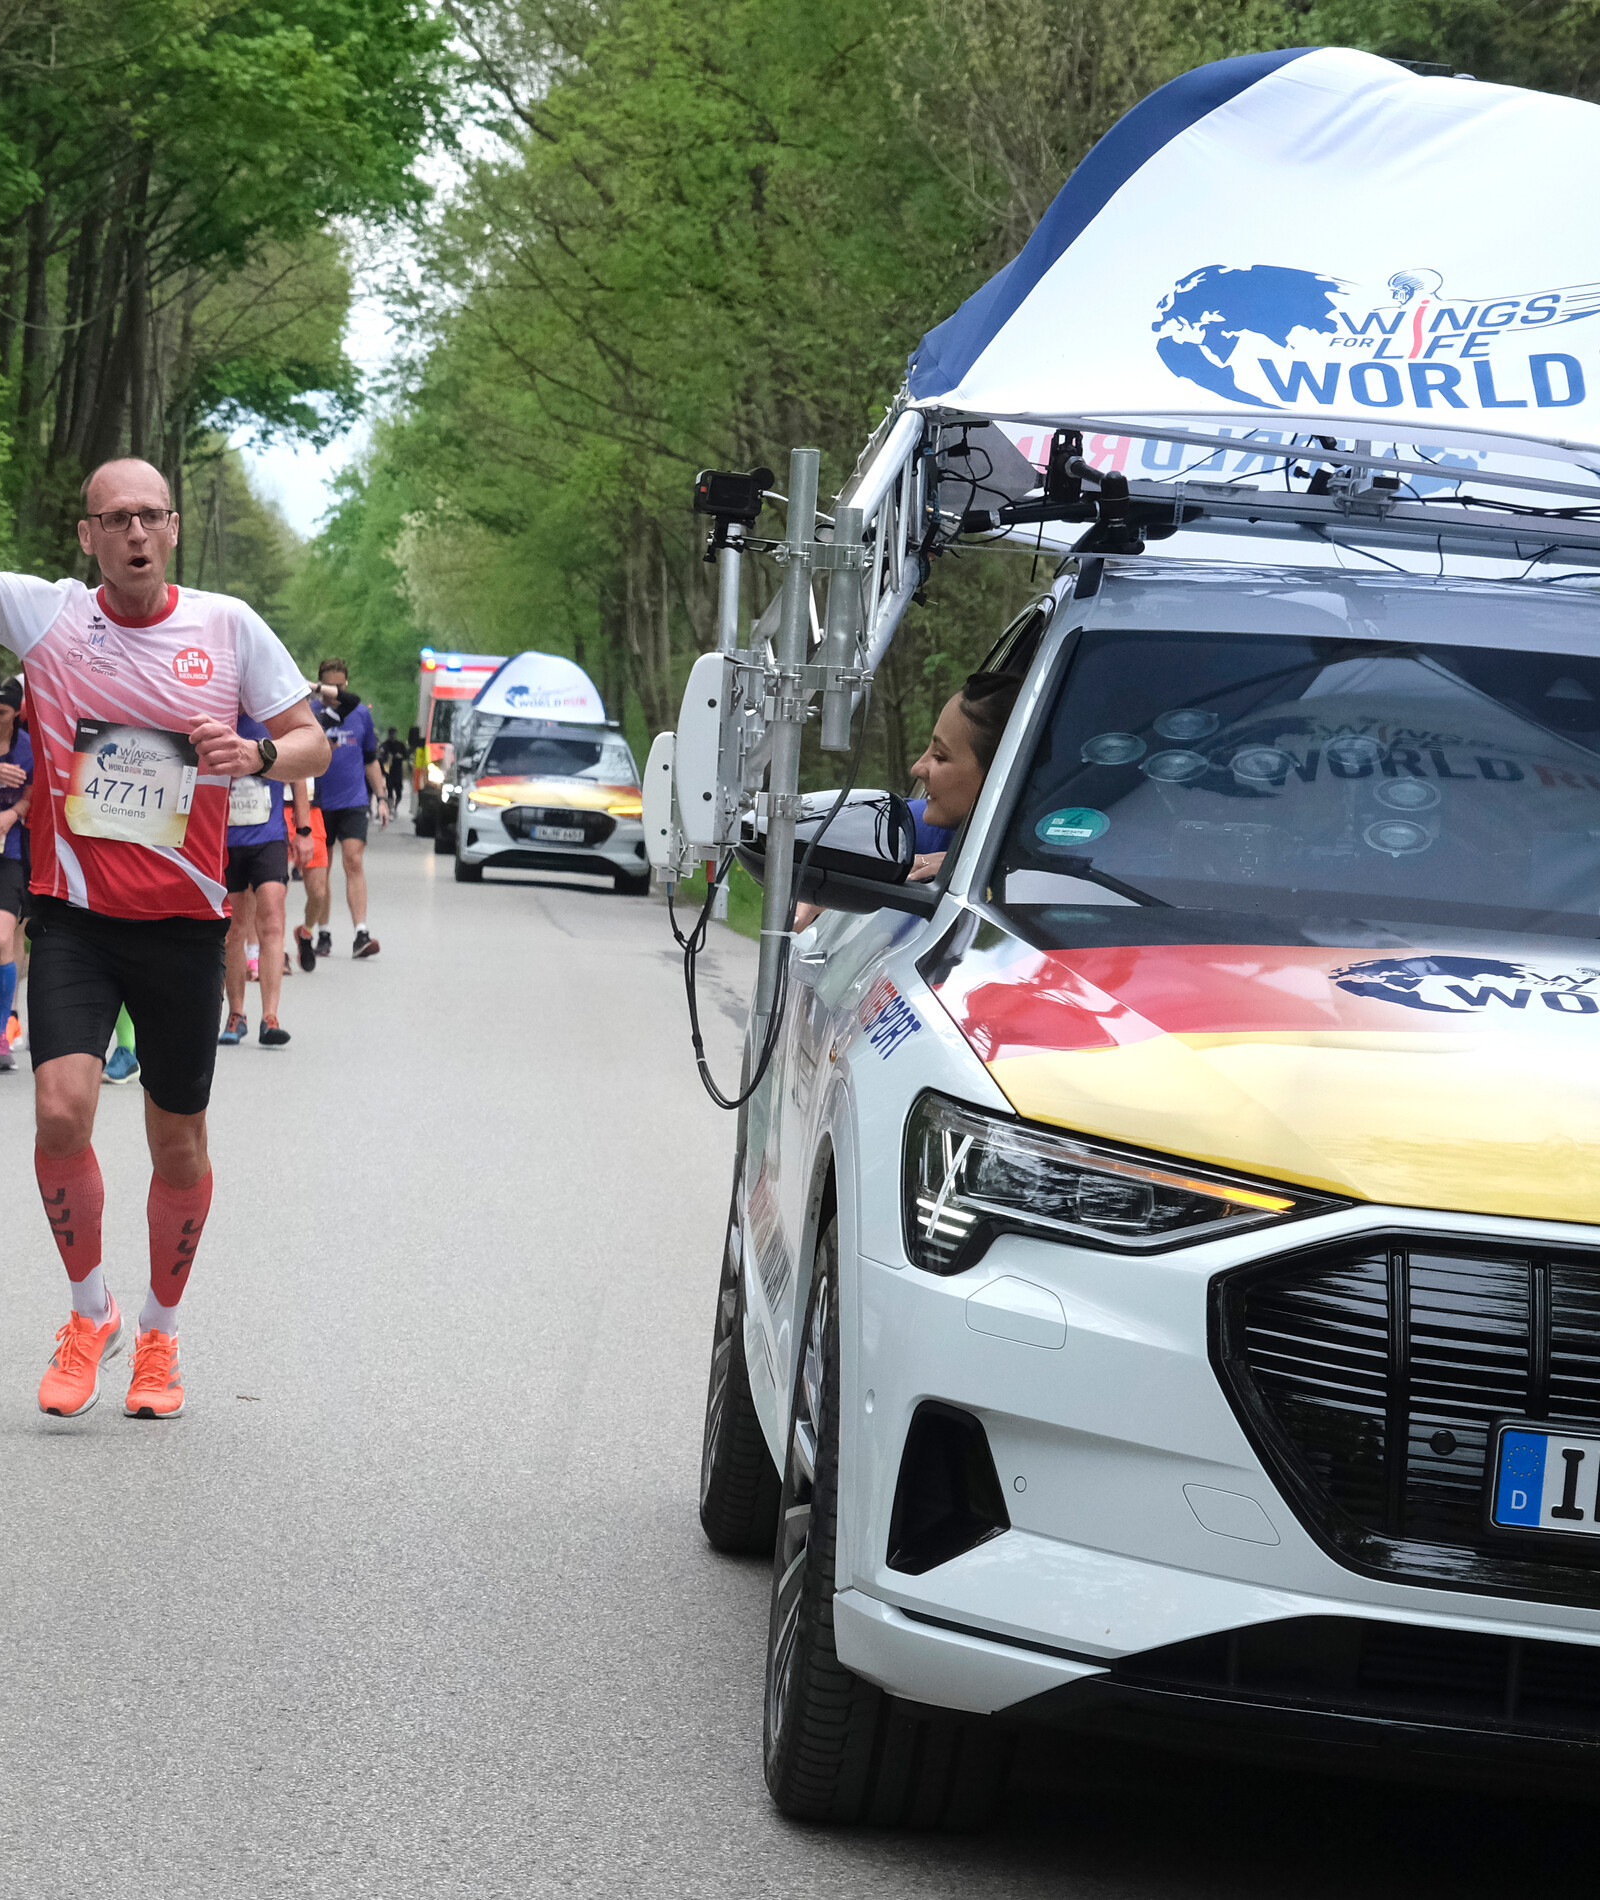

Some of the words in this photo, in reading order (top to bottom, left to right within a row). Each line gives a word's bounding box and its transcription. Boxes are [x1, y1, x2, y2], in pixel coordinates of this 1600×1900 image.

[1338, 294, 1562, 336] WINGS
[1329, 337, 1375, 348] FOR
[1371, 330, 1501, 359] LIFE
[1255, 353, 1586, 409] WORLD
[120, 747, 158, 760] WINGS
[108, 763, 129, 773] WORLD
[142, 768, 157, 777] 2022
[84, 777, 165, 809] 47711
[181, 794, 189, 809] 1
[100, 803, 146, 818] Clemens
[1518, 979, 1565, 987] FOR
[1510, 1489, 1528, 1510] D
